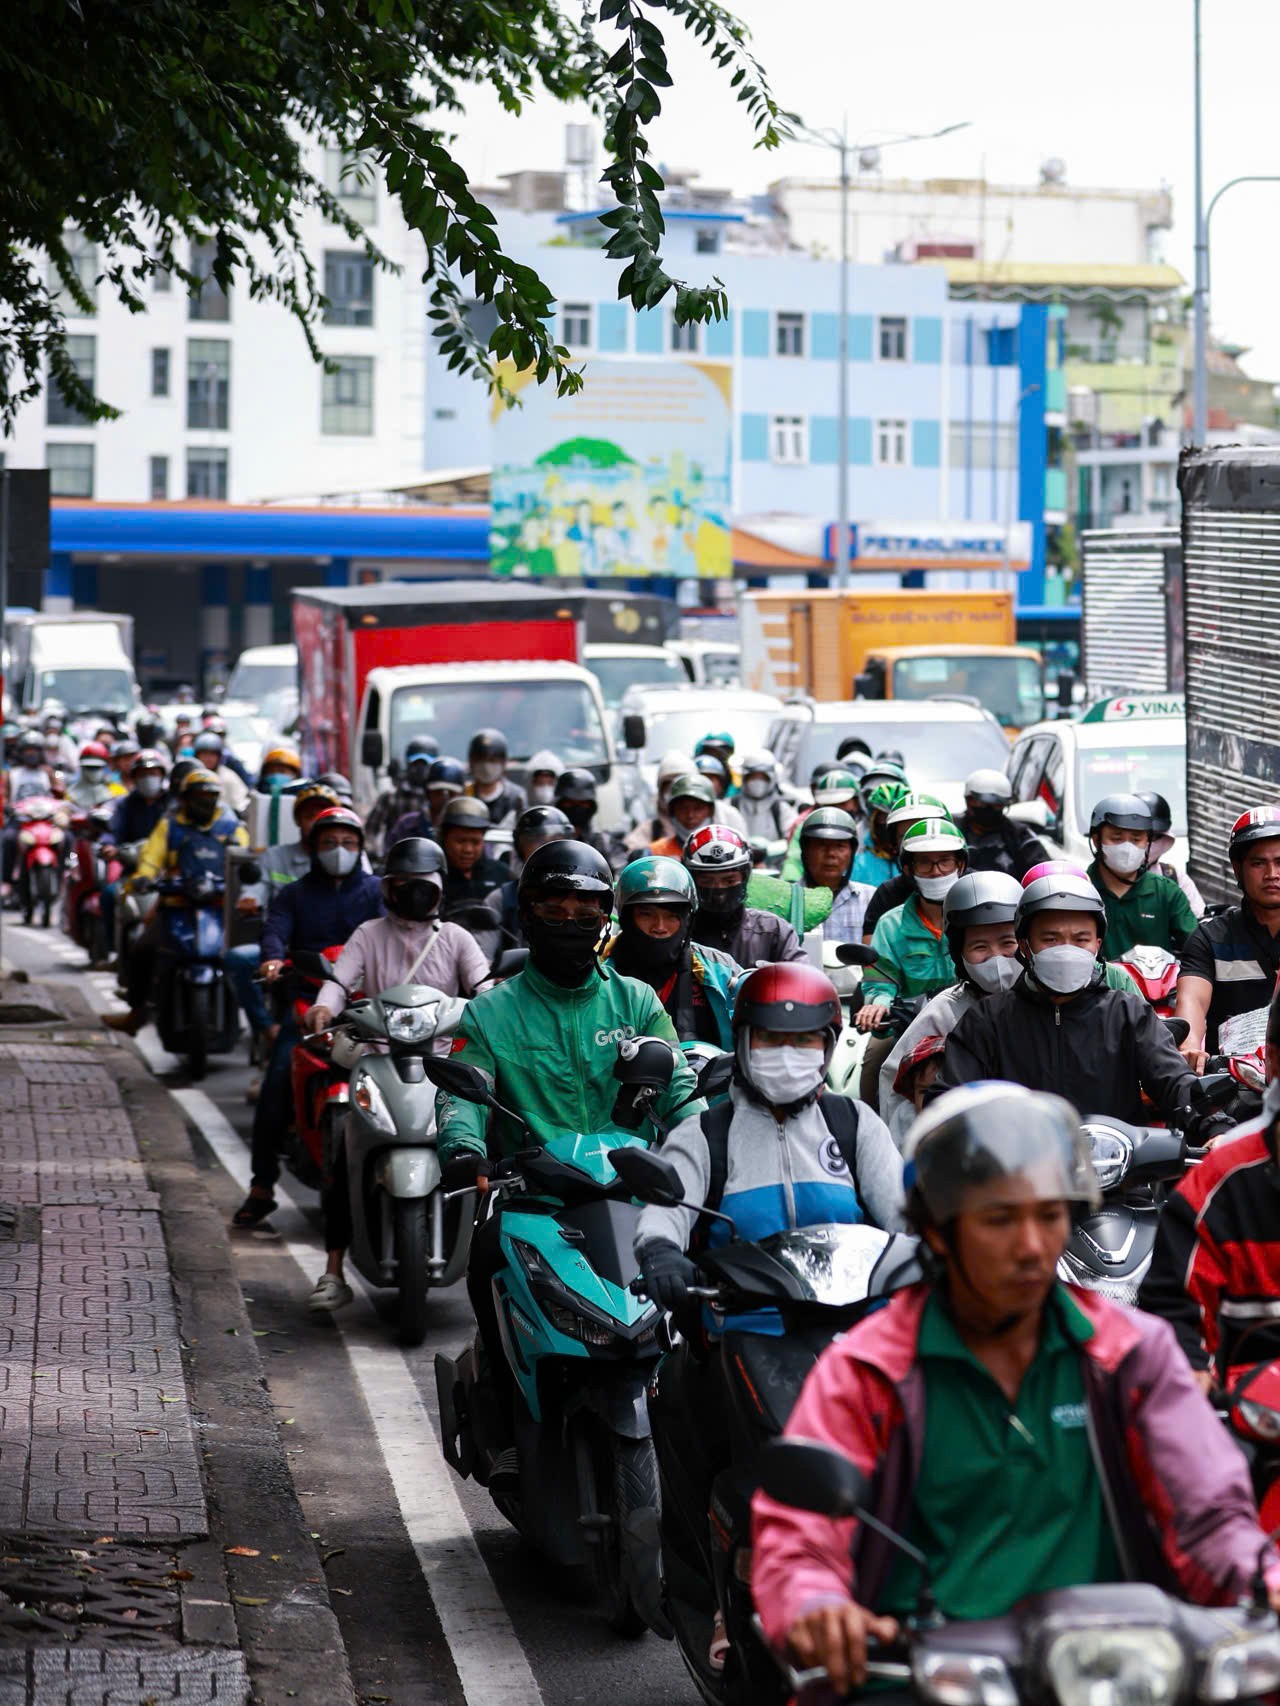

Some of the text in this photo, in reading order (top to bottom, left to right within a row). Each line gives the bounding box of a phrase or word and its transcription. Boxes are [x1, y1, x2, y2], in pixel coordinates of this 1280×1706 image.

[865, 536, 1006, 552] PETROLIMEX
[1141, 702, 1185, 714] VINA
[595, 1025, 635, 1047] Grab
